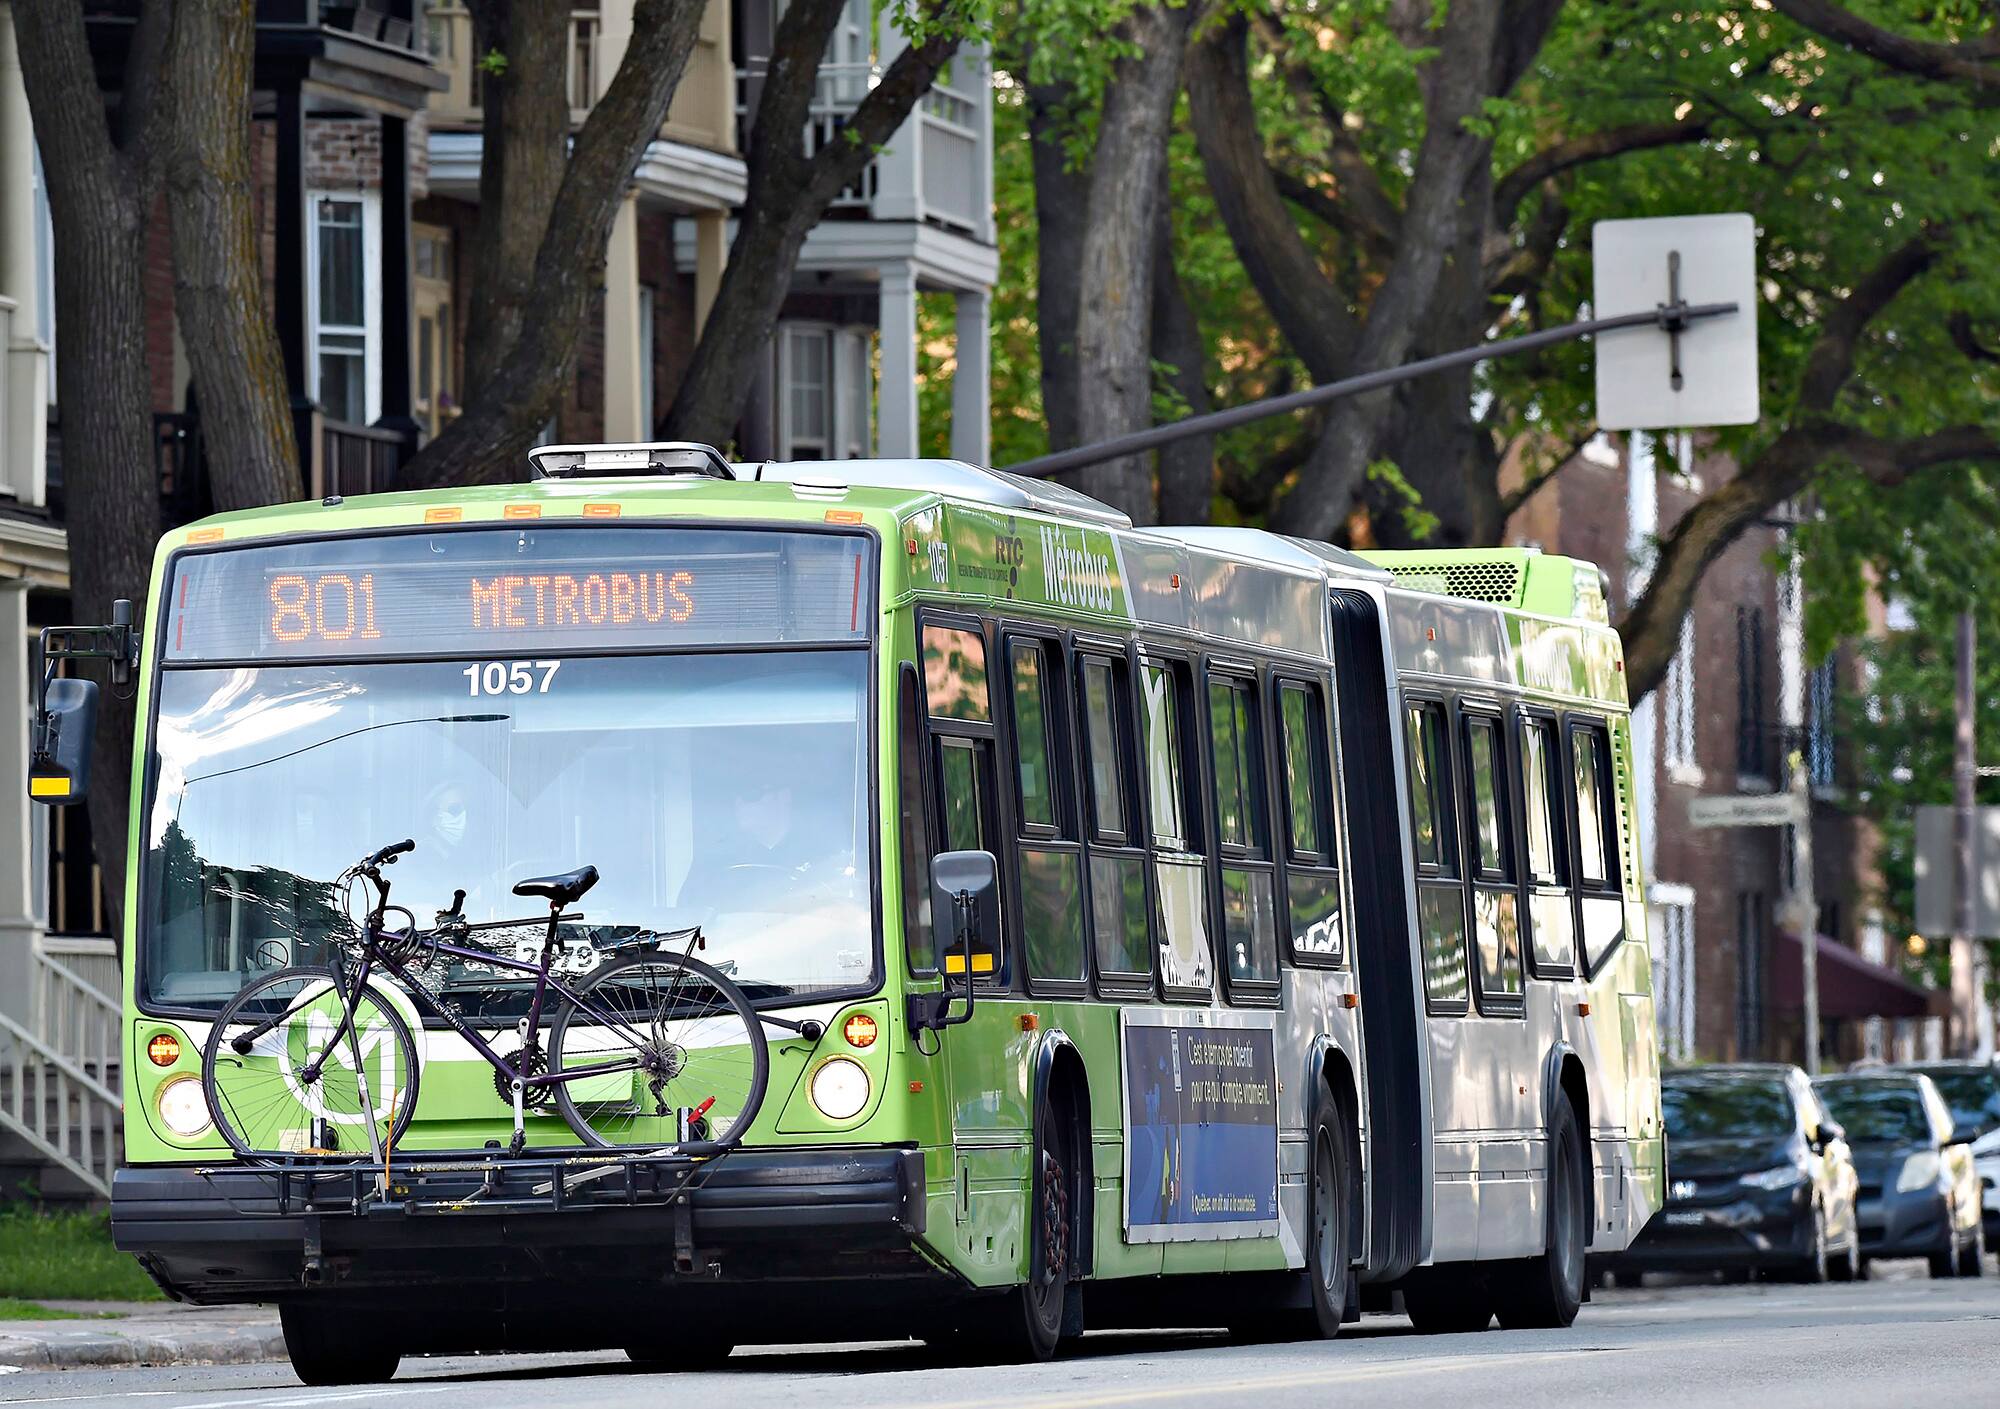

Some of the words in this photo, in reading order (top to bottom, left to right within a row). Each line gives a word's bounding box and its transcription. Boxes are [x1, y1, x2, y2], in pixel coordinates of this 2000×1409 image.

[928, 540, 949, 583] 1057
[995, 535, 1024, 567] RTC
[1040, 524, 1112, 611] Métrobus
[270, 573, 381, 641] 801
[471, 572, 694, 627] METROBUS
[462, 660, 561, 697] 1057
[522, 946, 593, 968] 279
